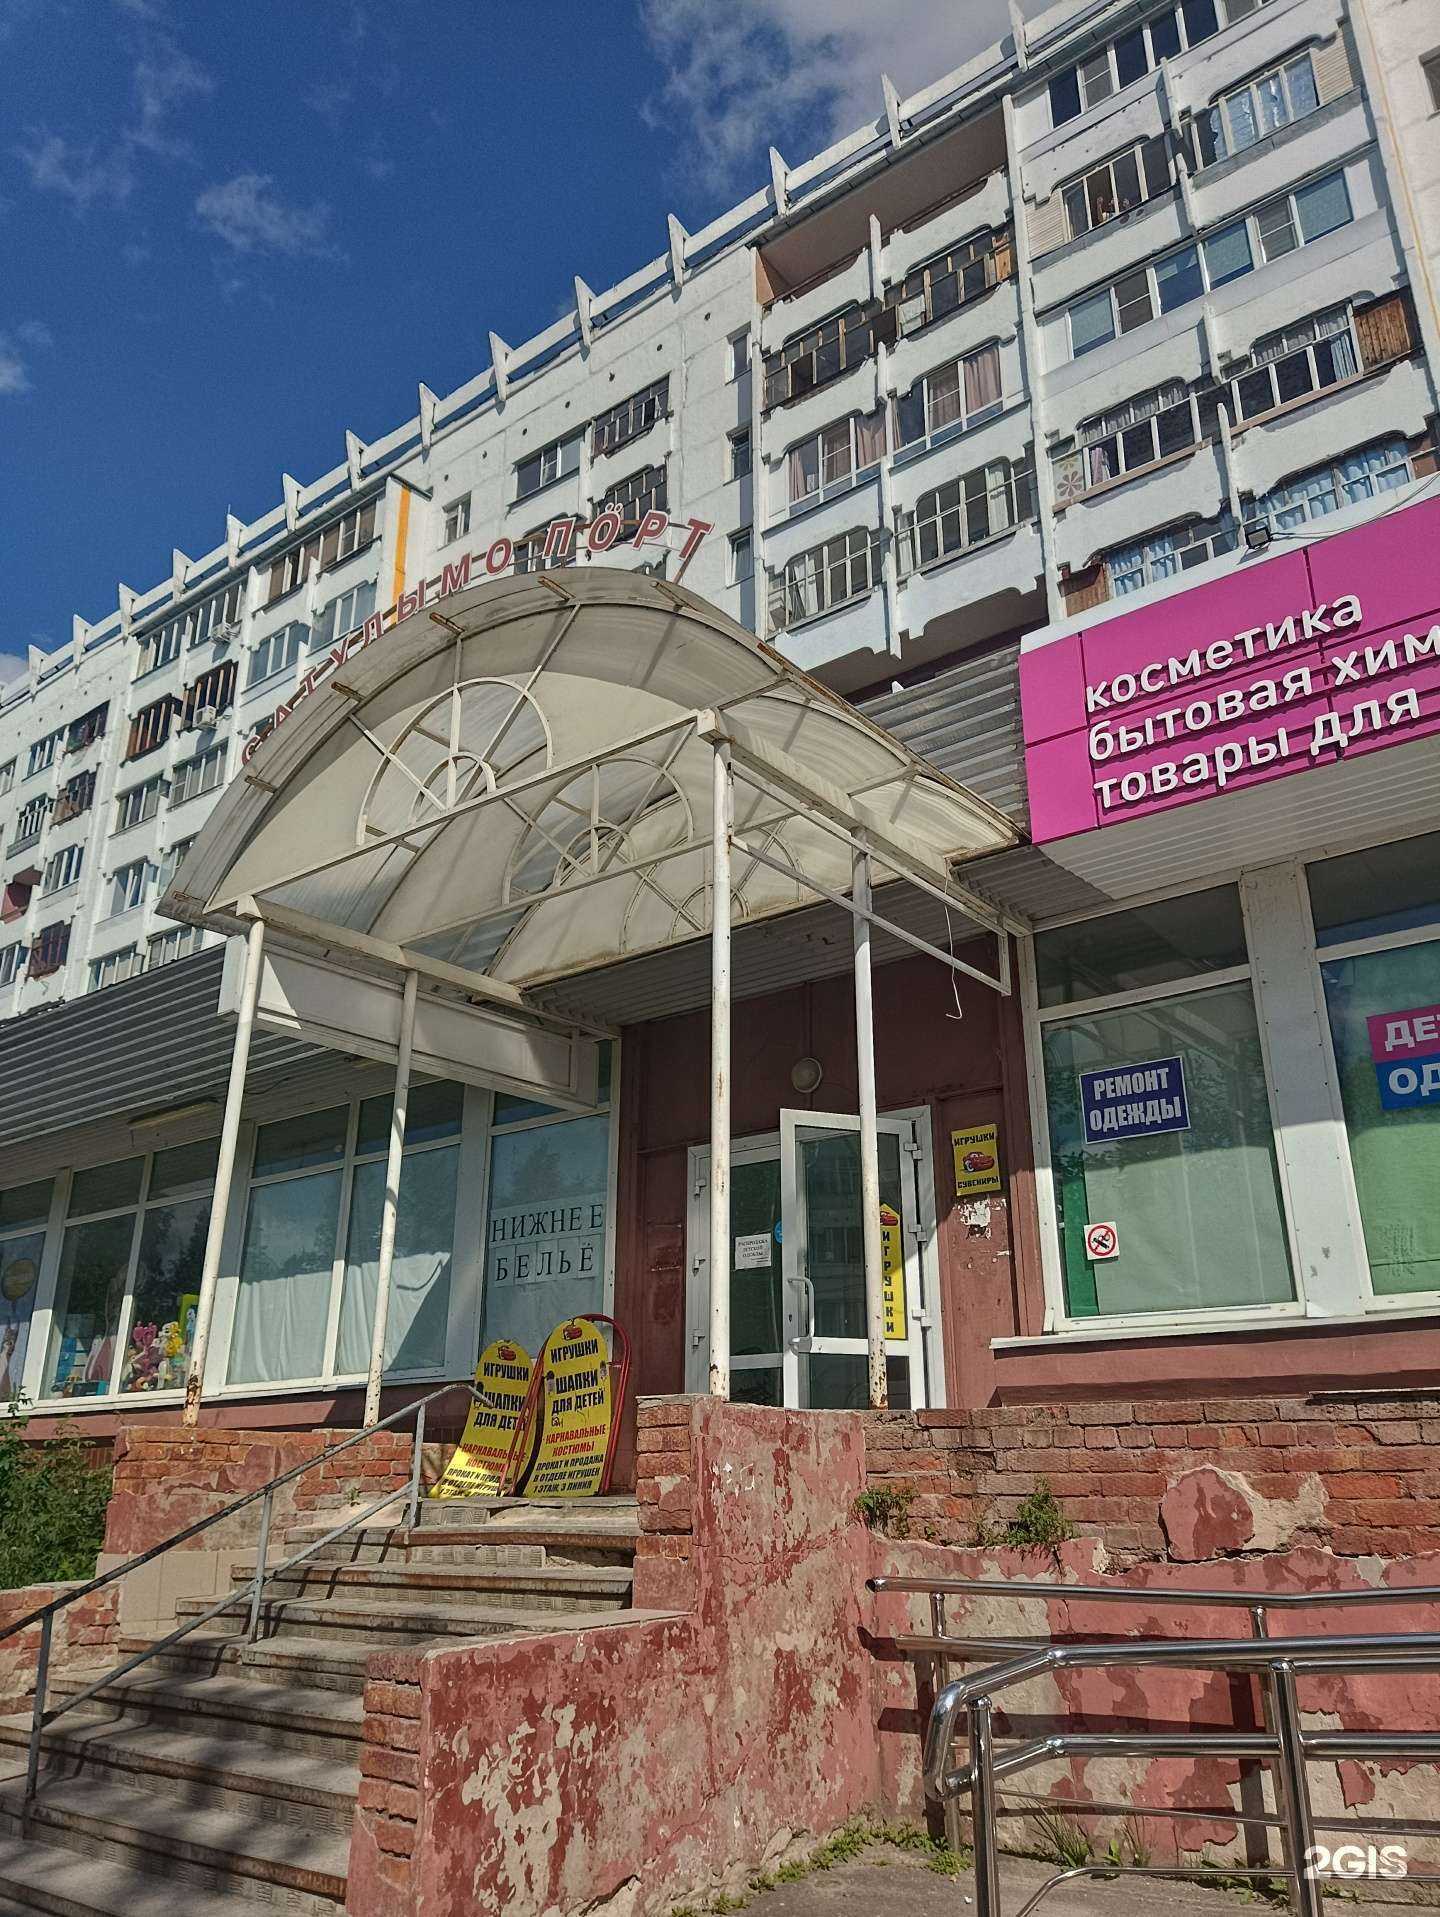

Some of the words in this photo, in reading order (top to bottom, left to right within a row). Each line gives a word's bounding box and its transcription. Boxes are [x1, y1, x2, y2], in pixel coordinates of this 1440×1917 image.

[1085, 594, 1363, 712] косметика
[1089, 666, 1312, 761] бытовая
[1332, 625, 1440, 686] хим
[1094, 727, 1289, 808] товары
[1311, 688, 1420, 756] для
[1385, 1014, 1440, 1051] ДЕ
[1093, 1068, 1169, 1101] РЕМОНТ
[1089, 1096, 1181, 1133] ОДЕЖДЫ
[954, 1132, 995, 1146] ИГРУШКИ
[957, 1176, 999, 1189] СУВЕНИРЫ
[490, 1204, 604, 1243] НИЖНЕЕ
[495, 1242, 594, 1282] БЕЛЬЁ
[882, 1231, 895, 1333] ИГРУШКИ
[551, 1339, 599, 1363] ИГРУШКИ
[484, 1362, 529, 1382] ИГРУШКИ
[556, 1369, 598, 1395] ШАПКИ
[552, 1397, 573, 1416] ДЛЯ
[574, 1388, 605, 1414] ДЕТЕЙ
[474, 1412, 497, 1428] ДЛЯ
[498, 1415, 527, 1431] ДЕТ
[545, 1424, 606, 1445] КАРНАВАЛЬНЫЕ
[552, 1441, 595, 1457] КОСТЮМЫ
[447, 1468, 475, 1479] ПРОКАТ
[536, 1459, 563, 1471] ПРОКАТ
[569, 1454, 604, 1467] ПРОДАЖА
[540, 1471, 567, 1482] ОТДЕЛЕ
[568, 1467, 600, 1480] ИГРУШЕК
